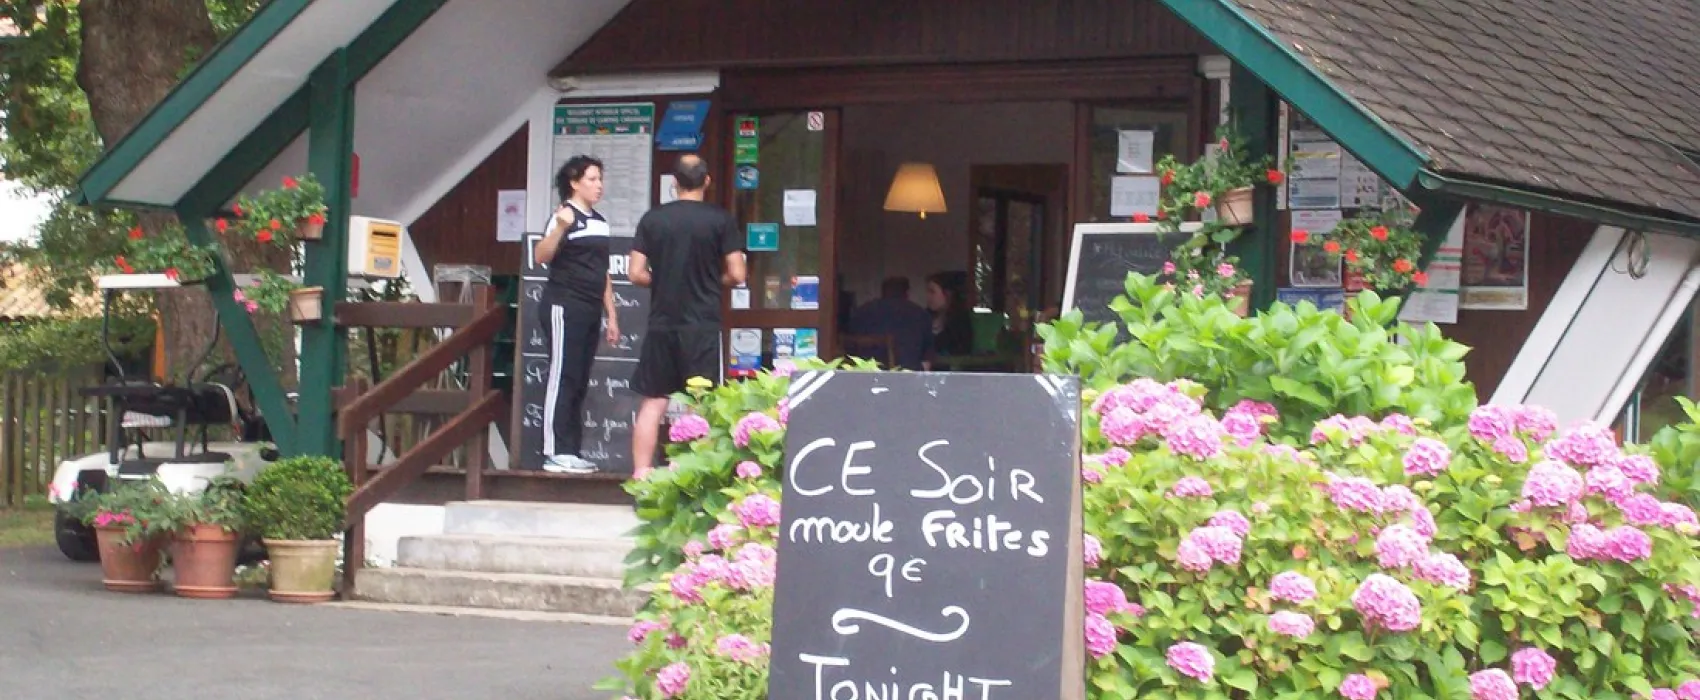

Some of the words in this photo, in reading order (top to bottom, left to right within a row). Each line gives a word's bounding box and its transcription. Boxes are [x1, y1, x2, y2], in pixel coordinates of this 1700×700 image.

[789, 437, 876, 496] CE
[789, 502, 894, 543] moule
[868, 553, 927, 598] 9€
